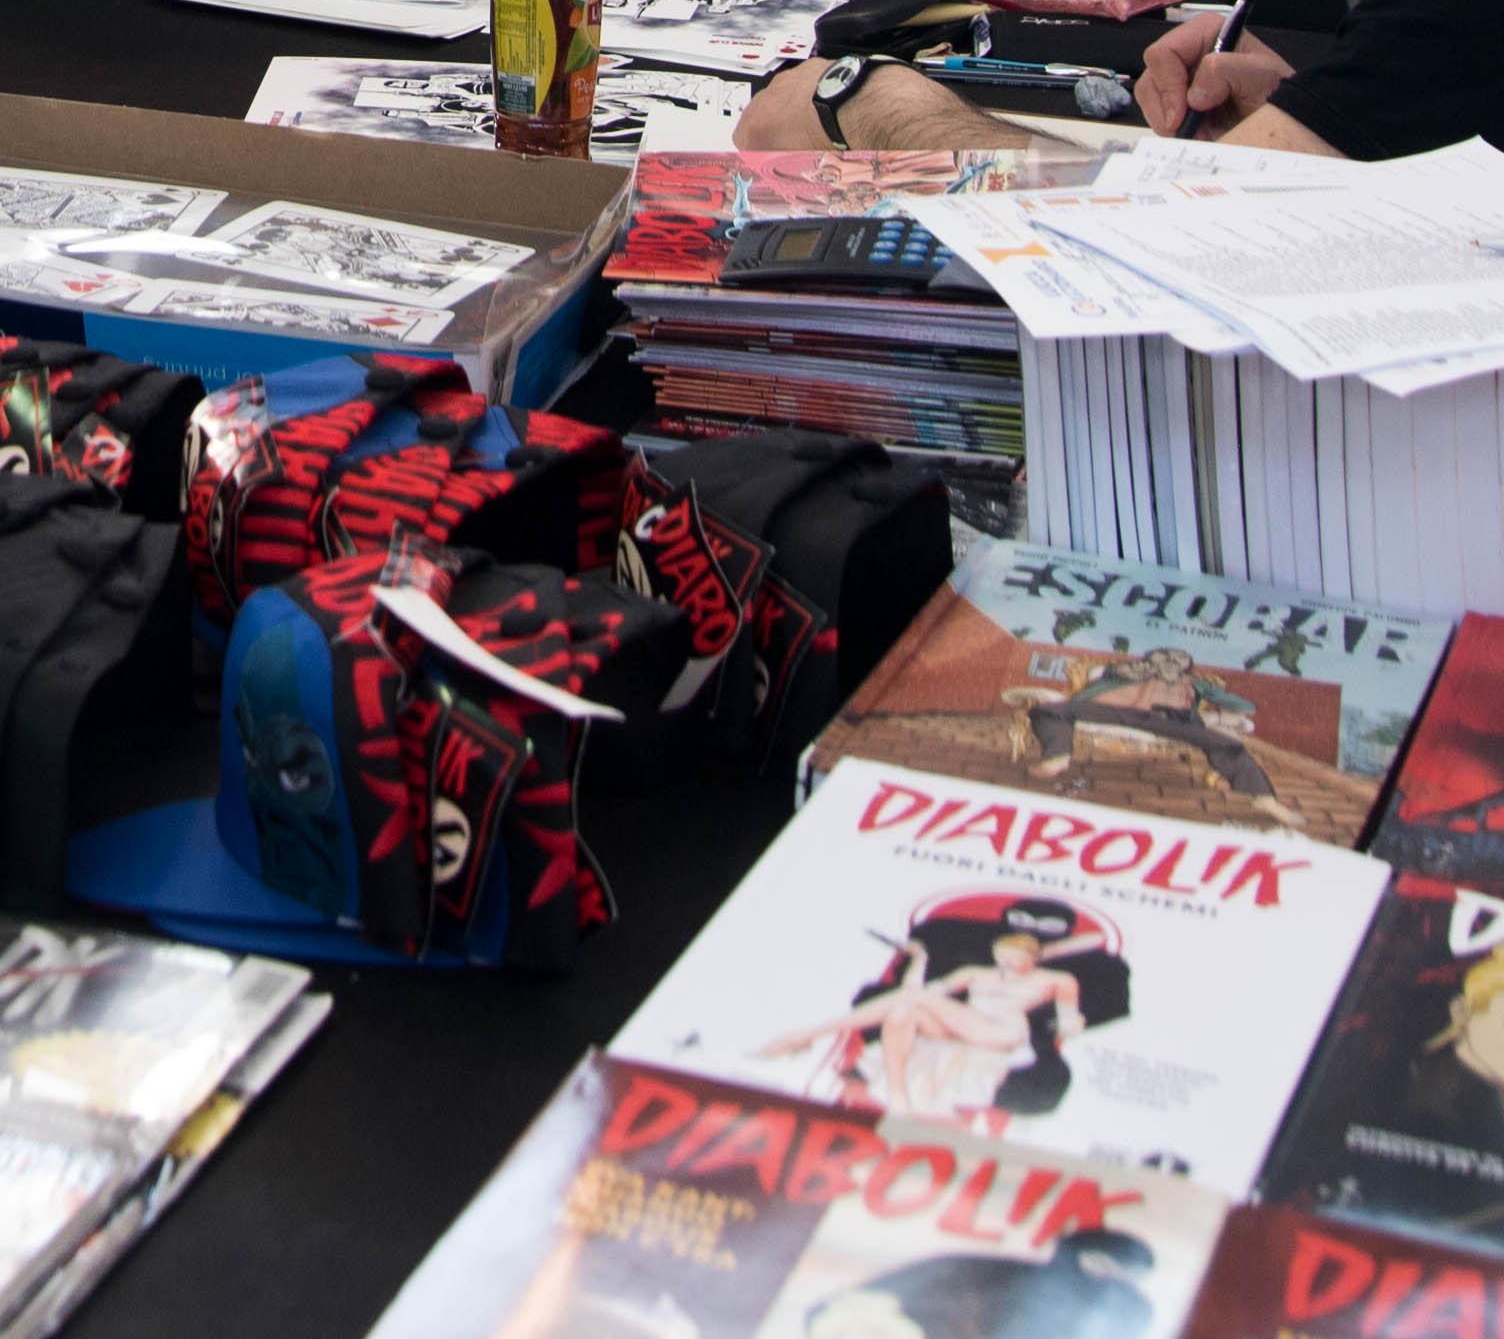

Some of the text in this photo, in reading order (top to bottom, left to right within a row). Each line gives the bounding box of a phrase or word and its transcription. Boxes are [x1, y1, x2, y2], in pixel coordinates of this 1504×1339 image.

[1003, 561, 1410, 664] ESCOBAR
[857, 779, 1311, 910] DIABOLIK
[892, 843, 1221, 920] FUORI DAGLI SCHEMI
[600, 1074, 1144, 1249] DIABOLIK
